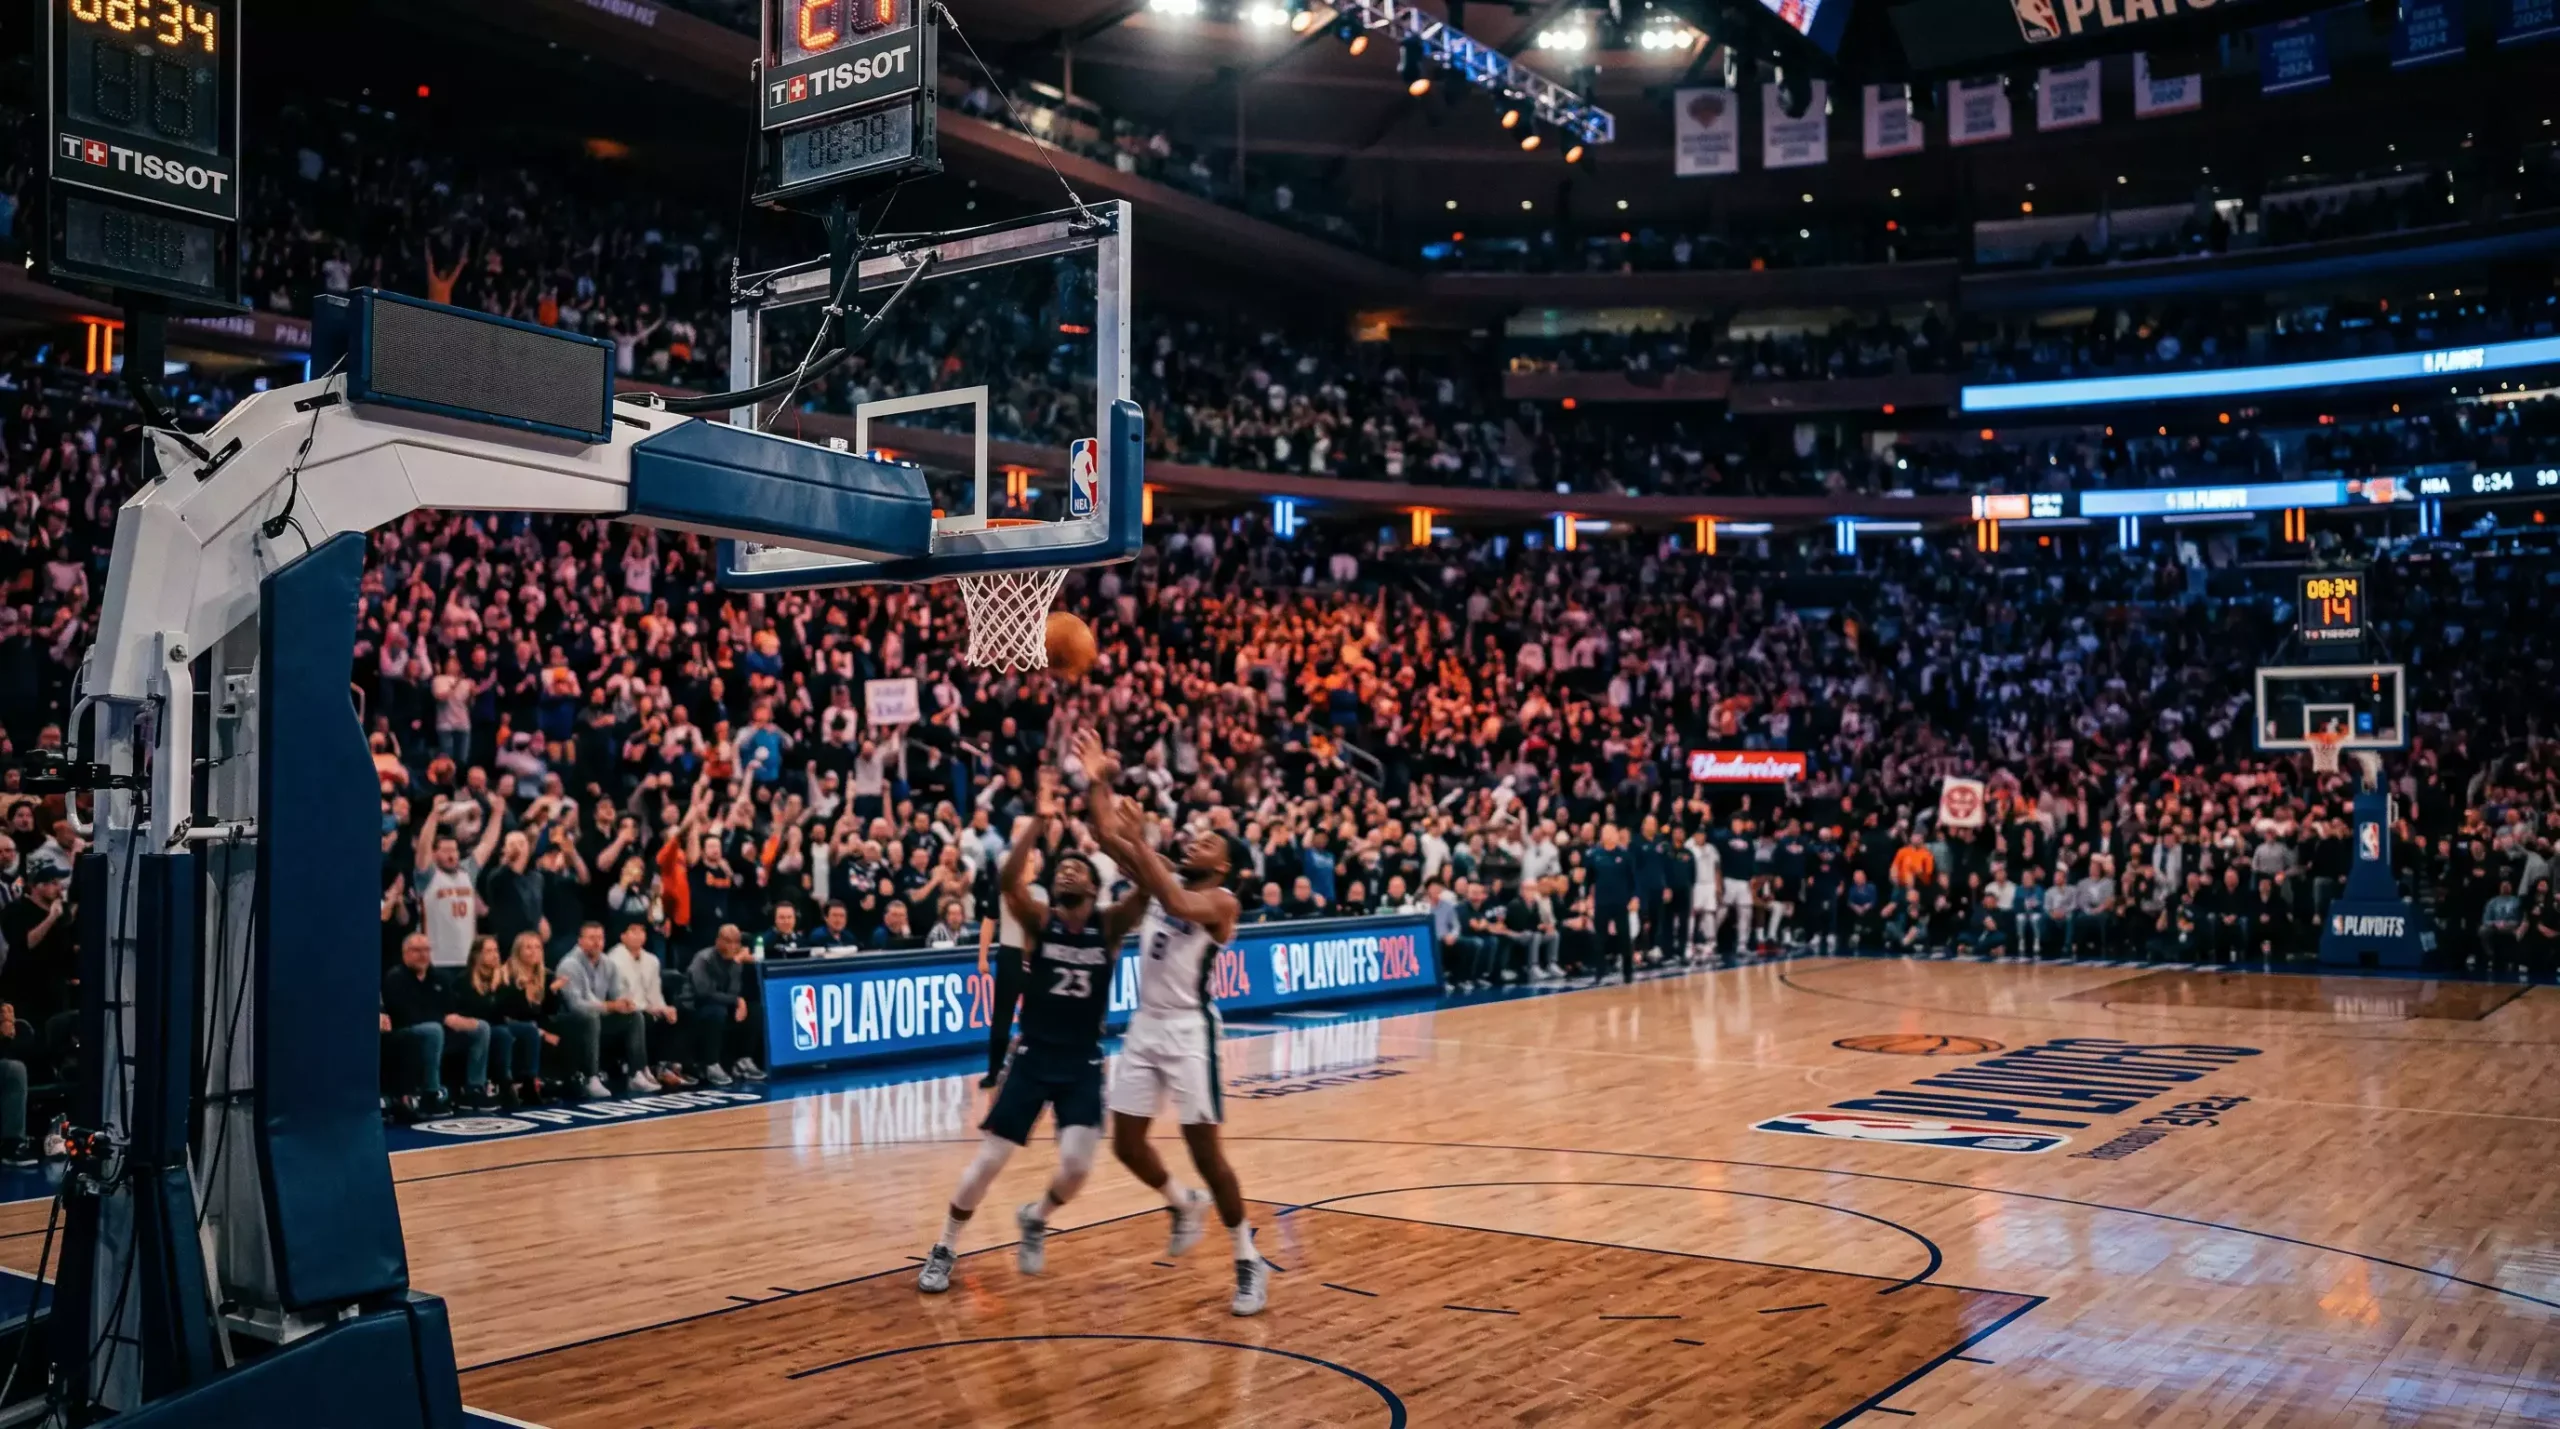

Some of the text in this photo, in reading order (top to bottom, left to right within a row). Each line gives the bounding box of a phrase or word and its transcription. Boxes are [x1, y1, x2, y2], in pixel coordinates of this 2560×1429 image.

[809, 45, 911, 96] TISSOT
[110, 146, 228, 194] TISSOT
[2307, 578, 2357, 599] 08:34
[2323, 598, 2351, 625] 14
[1692, 753, 1801, 778] Budweiser
[2344, 915, 2405, 937] PLAYOFFS
[1048, 966, 1093, 998] 23
[1210, 949, 1250, 999] 024
[1289, 935, 1420, 992] PLAYOFFS 2024
[822, 973, 995, 1047] PLAYOFFS 20
[1828, 1037, 2264, 1129] PLAYOFFS
[513, 1090, 763, 1124] PLAYOFFS
